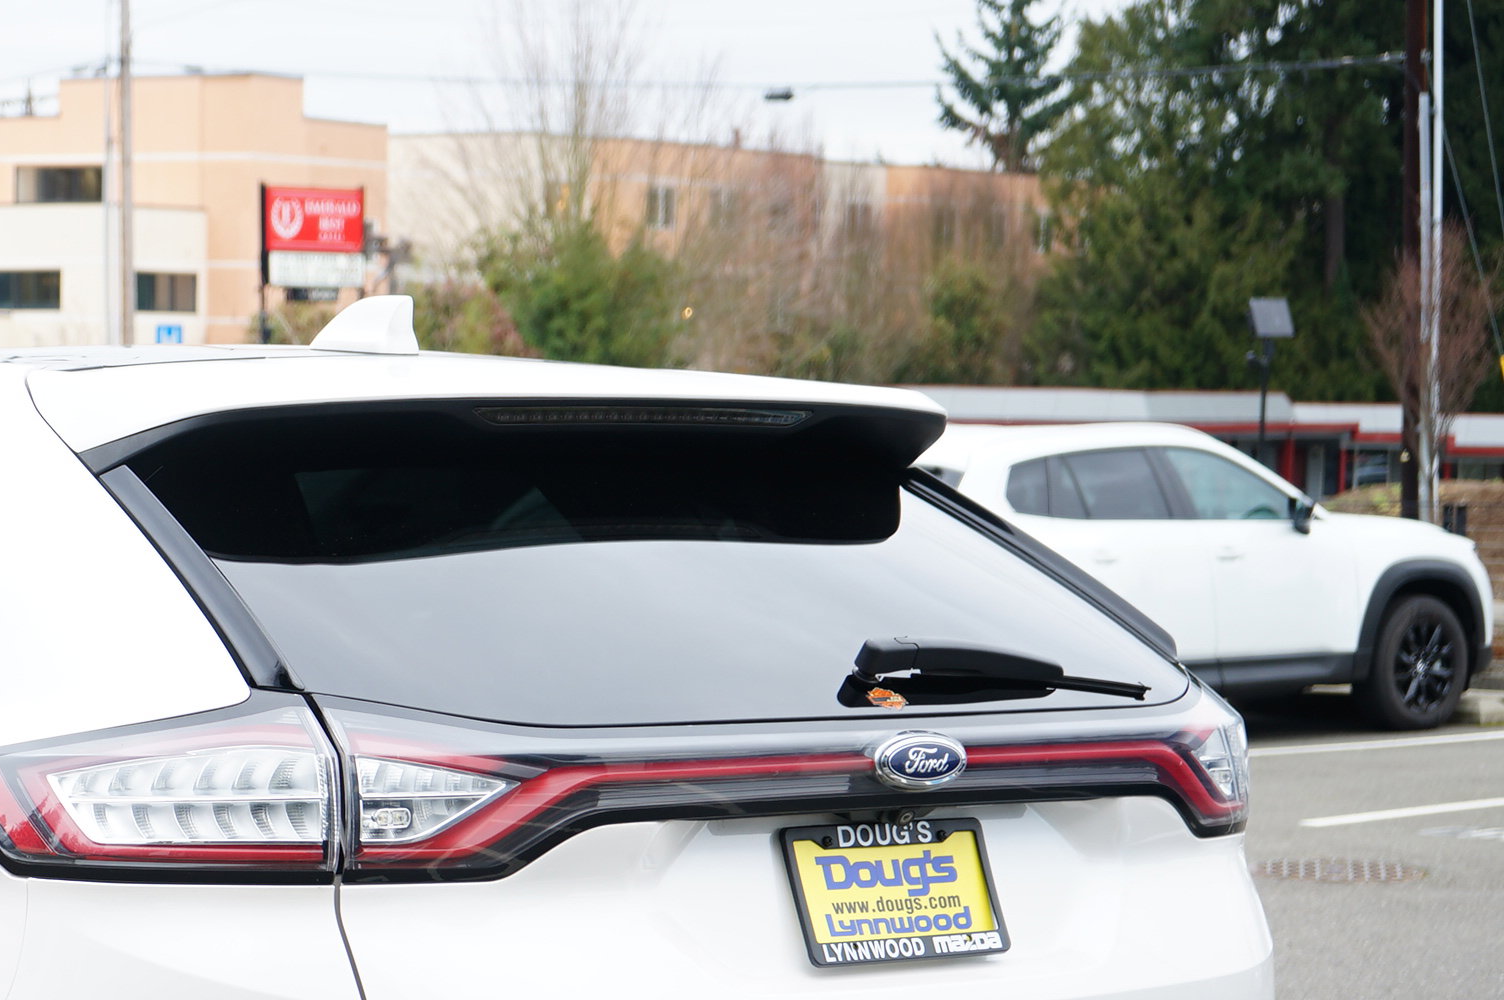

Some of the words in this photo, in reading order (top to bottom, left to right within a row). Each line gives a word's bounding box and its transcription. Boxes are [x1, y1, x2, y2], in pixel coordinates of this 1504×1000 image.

[904, 746, 950, 774] Ford
[836, 820, 933, 848] DOUG'S
[831, 894, 962, 915] www.dougs.com
[824, 905, 973, 937] Lynnwood
[821, 937, 926, 963] LYNNWOOD
